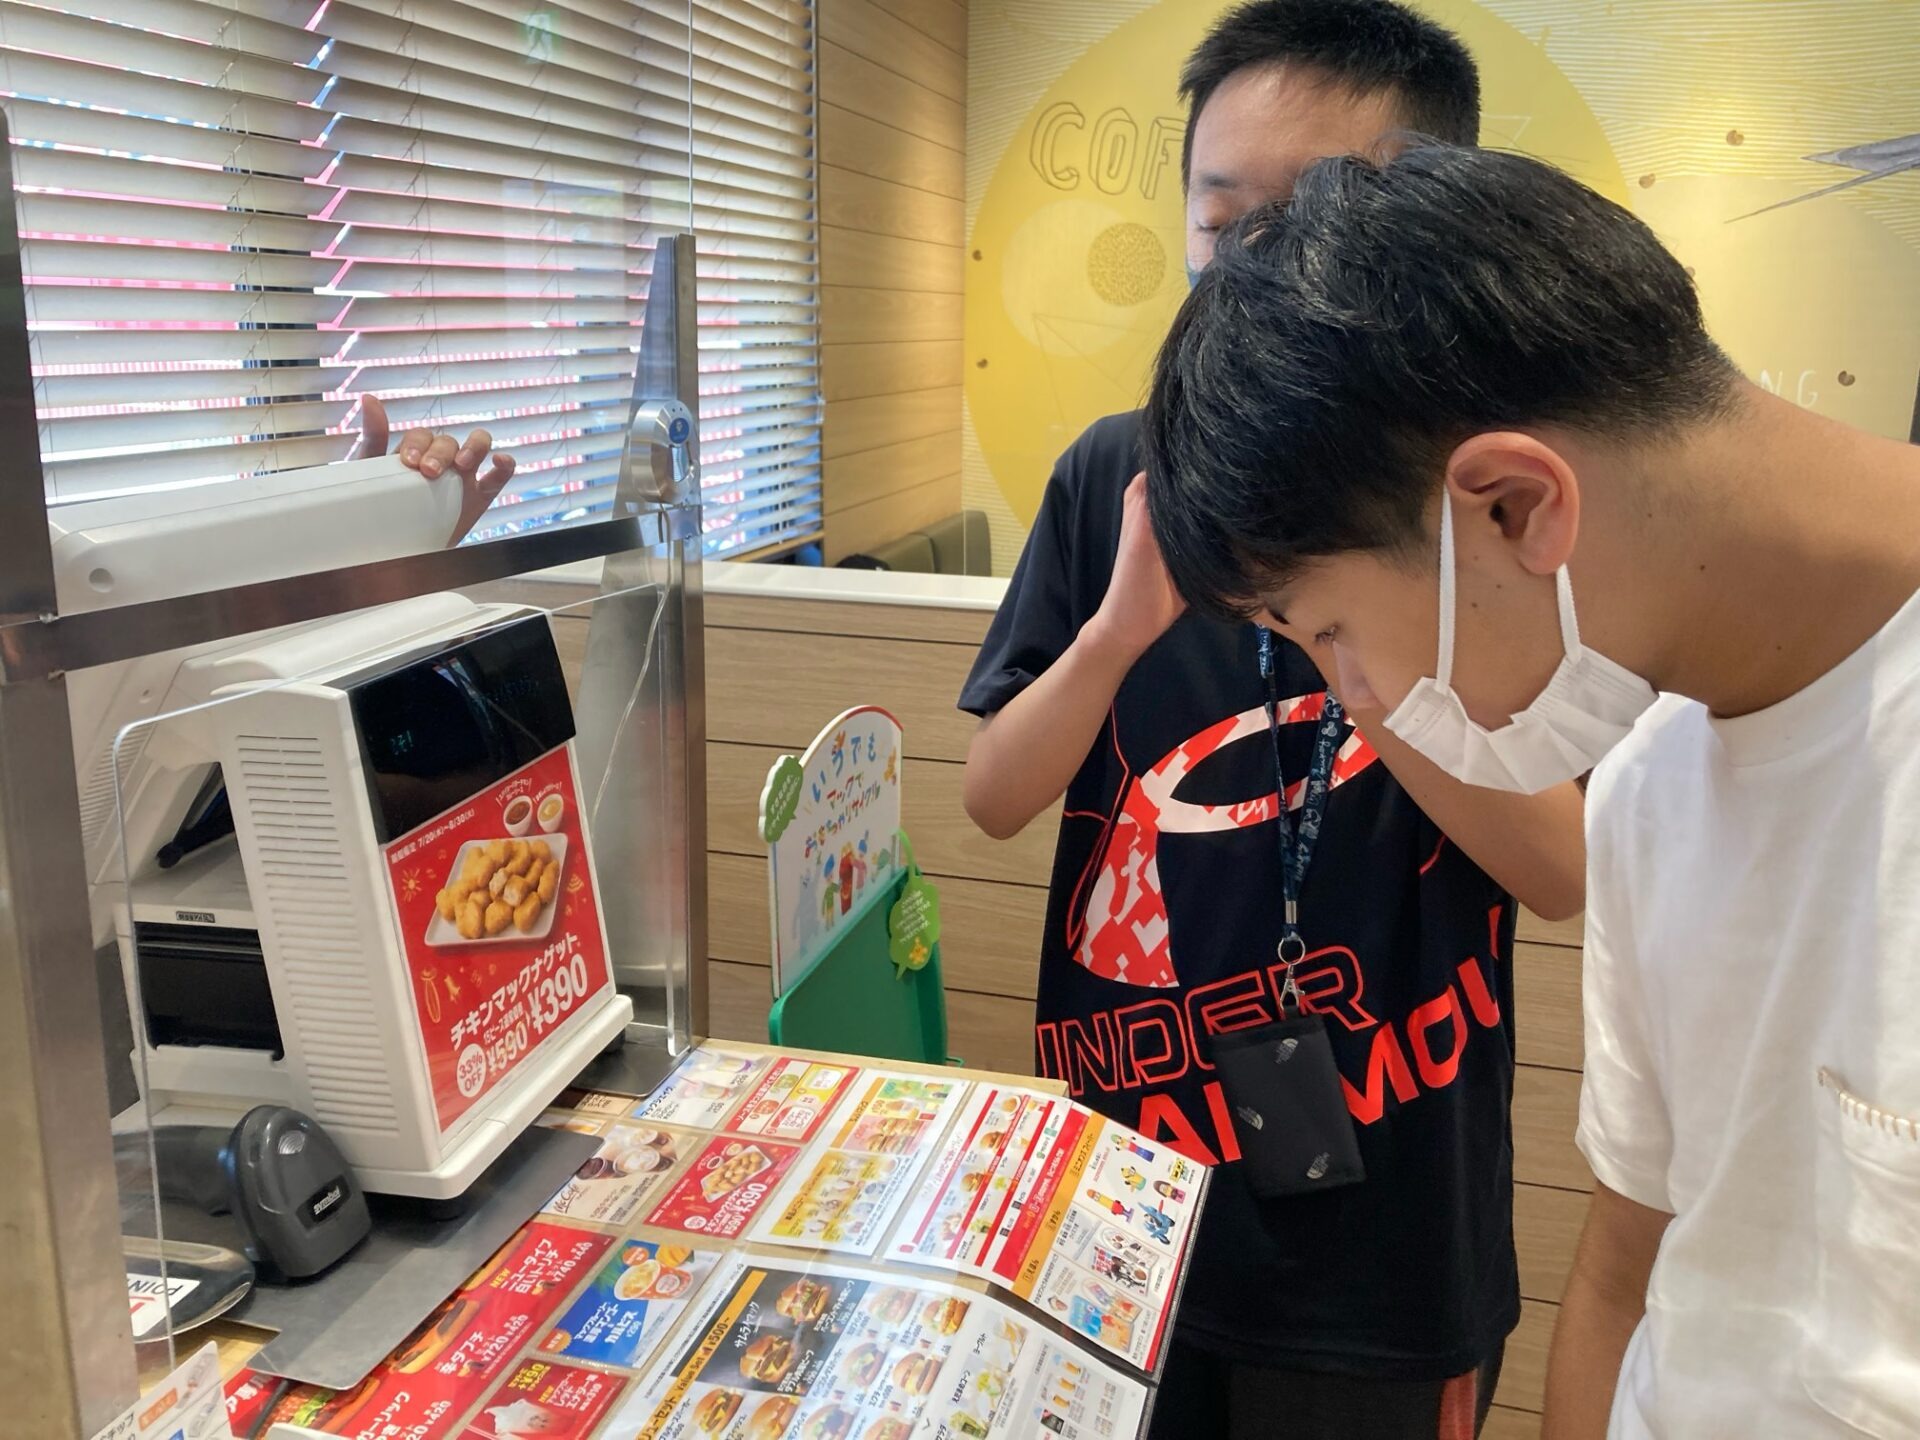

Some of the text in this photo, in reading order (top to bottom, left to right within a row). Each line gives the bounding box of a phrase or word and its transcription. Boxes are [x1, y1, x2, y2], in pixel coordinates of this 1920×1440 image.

[450, 932, 578, 1051] チキンマックナゲット
[527, 953, 588, 1035] ¥390
[459, 1052, 483, 1080] 33%
[464, 1070, 483, 1092] OFF
[733, 1182, 767, 1214] ¥390
[490, 1267, 511, 1289] NEW
[501, 1238, 552, 1290] ニュータイプ
[515, 1250, 560, 1295] 白いトリチ
[551, 1258, 577, 1283] ¥740
[604, 1311, 638, 1344] カルピス
[439, 1331, 485, 1375] 辛ダブチ
[481, 1333, 509, 1363] ¥720
